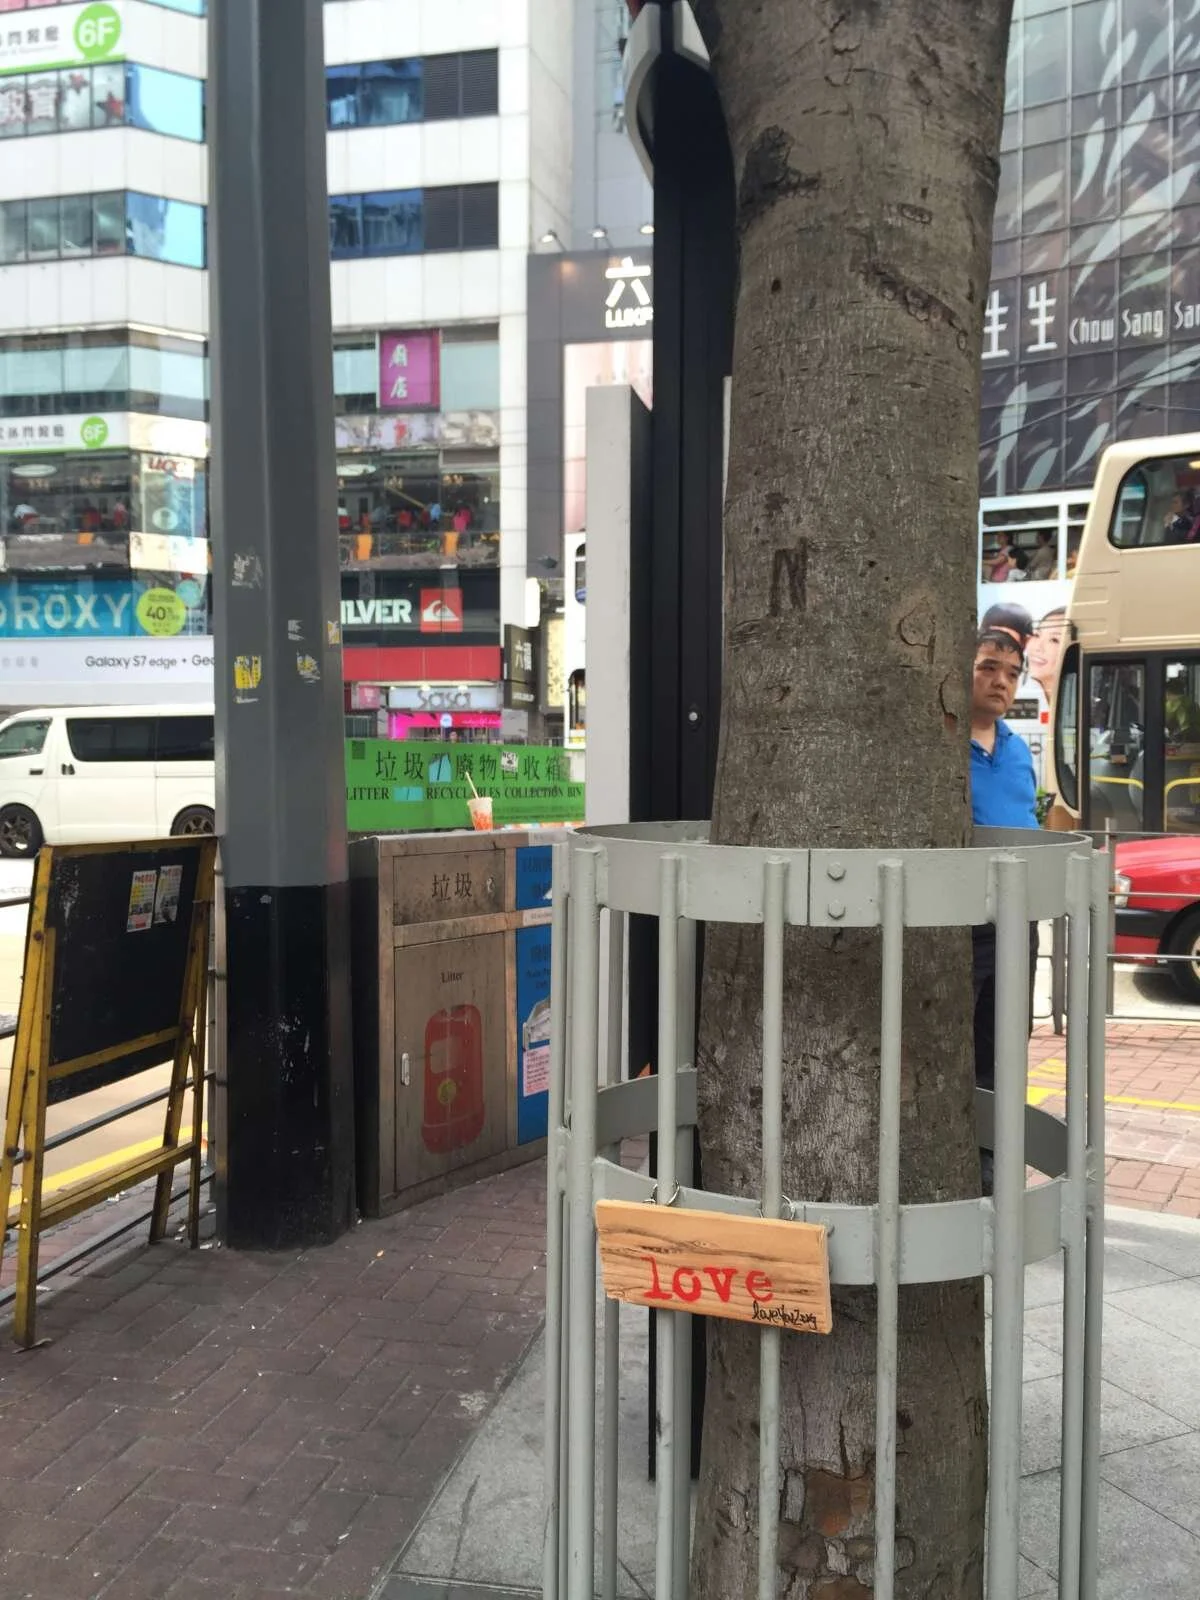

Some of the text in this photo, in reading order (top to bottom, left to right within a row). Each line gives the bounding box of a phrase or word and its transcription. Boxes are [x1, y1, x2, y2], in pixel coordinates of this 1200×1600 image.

[79, 17, 116, 48] 6F
[605, 256, 651, 307] 六
[1069, 317, 1114, 345] Chow
[1122, 308, 1163, 338] Sang
[14, 593, 132, 630] ROXY
[85, 656, 130, 669] Galaxy
[133, 656, 147, 667] S7
[149, 658, 177, 670] edge
[505, 786, 564, 799] COLLECTION
[568, 787, 582, 798] BIN
[431, 873, 473, 899] 垃圾
[441, 970, 464, 984] Litter
[641, 1256, 774, 1303] love
